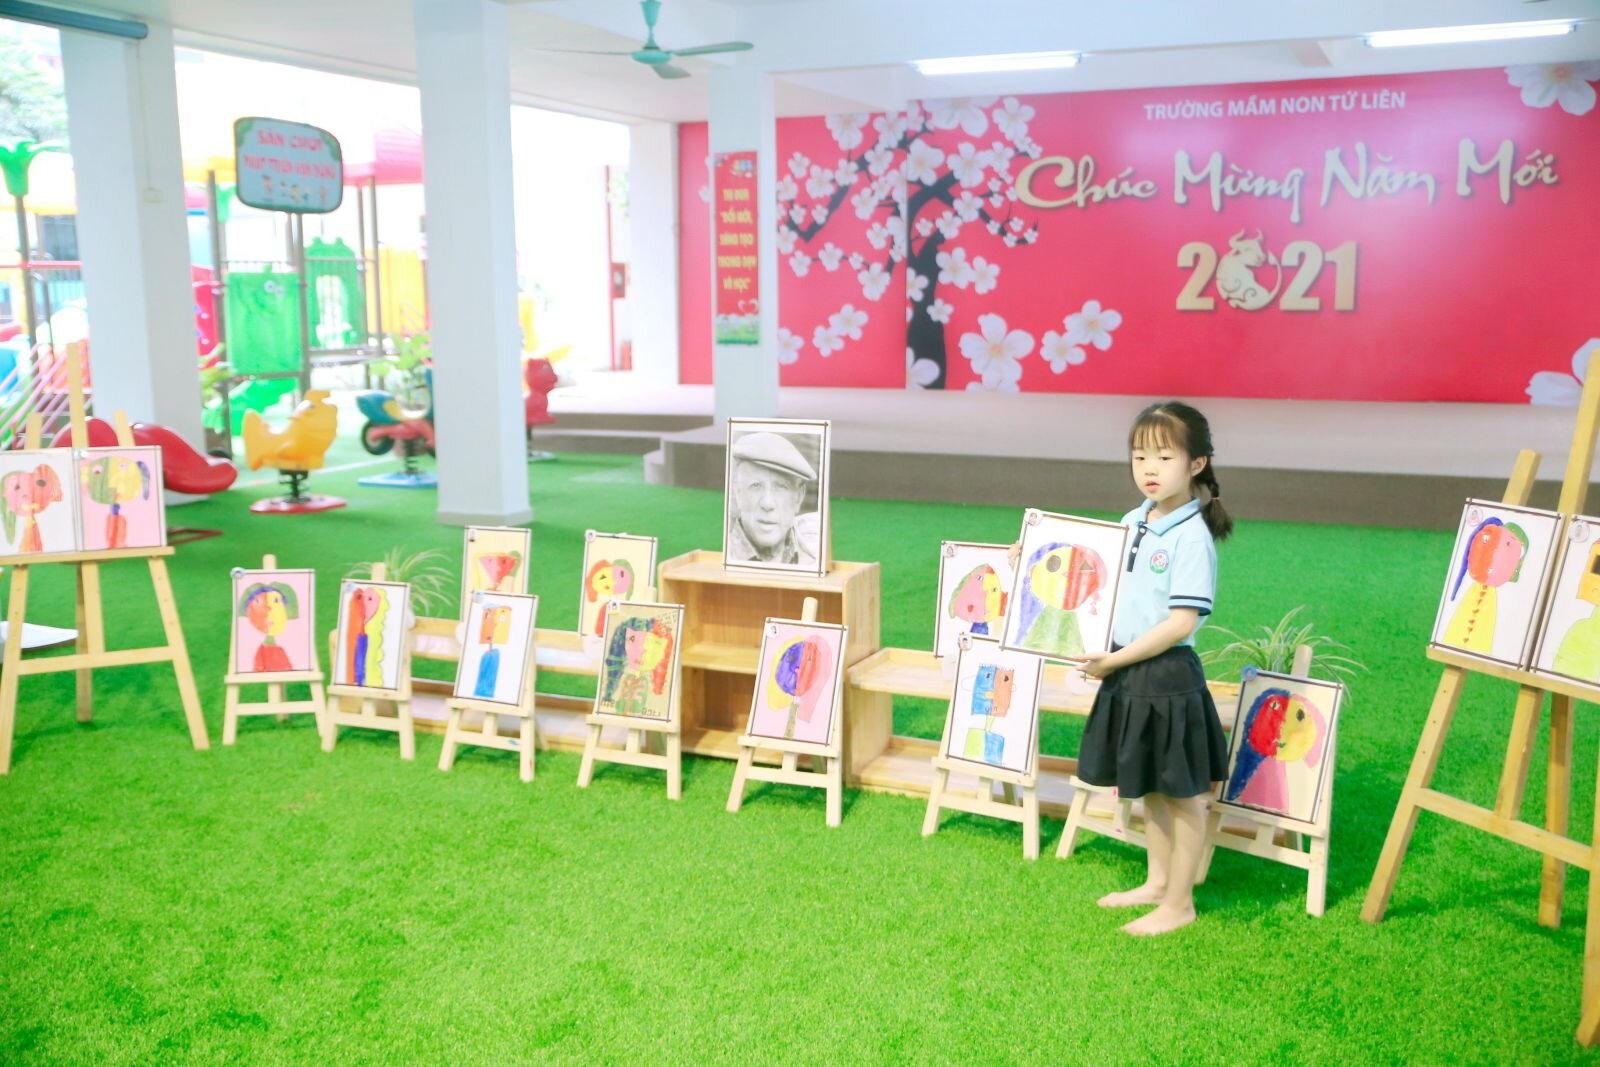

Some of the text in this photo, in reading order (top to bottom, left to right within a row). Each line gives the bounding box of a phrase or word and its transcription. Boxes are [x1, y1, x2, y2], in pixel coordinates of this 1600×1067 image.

[1144, 99, 1223, 120] TRƯỜNG
[1281, 96, 1325, 113] NON
[1361, 89, 1406, 110] LIÊN
[1015, 137, 1559, 224] Chúc Mừng Năm Mới
